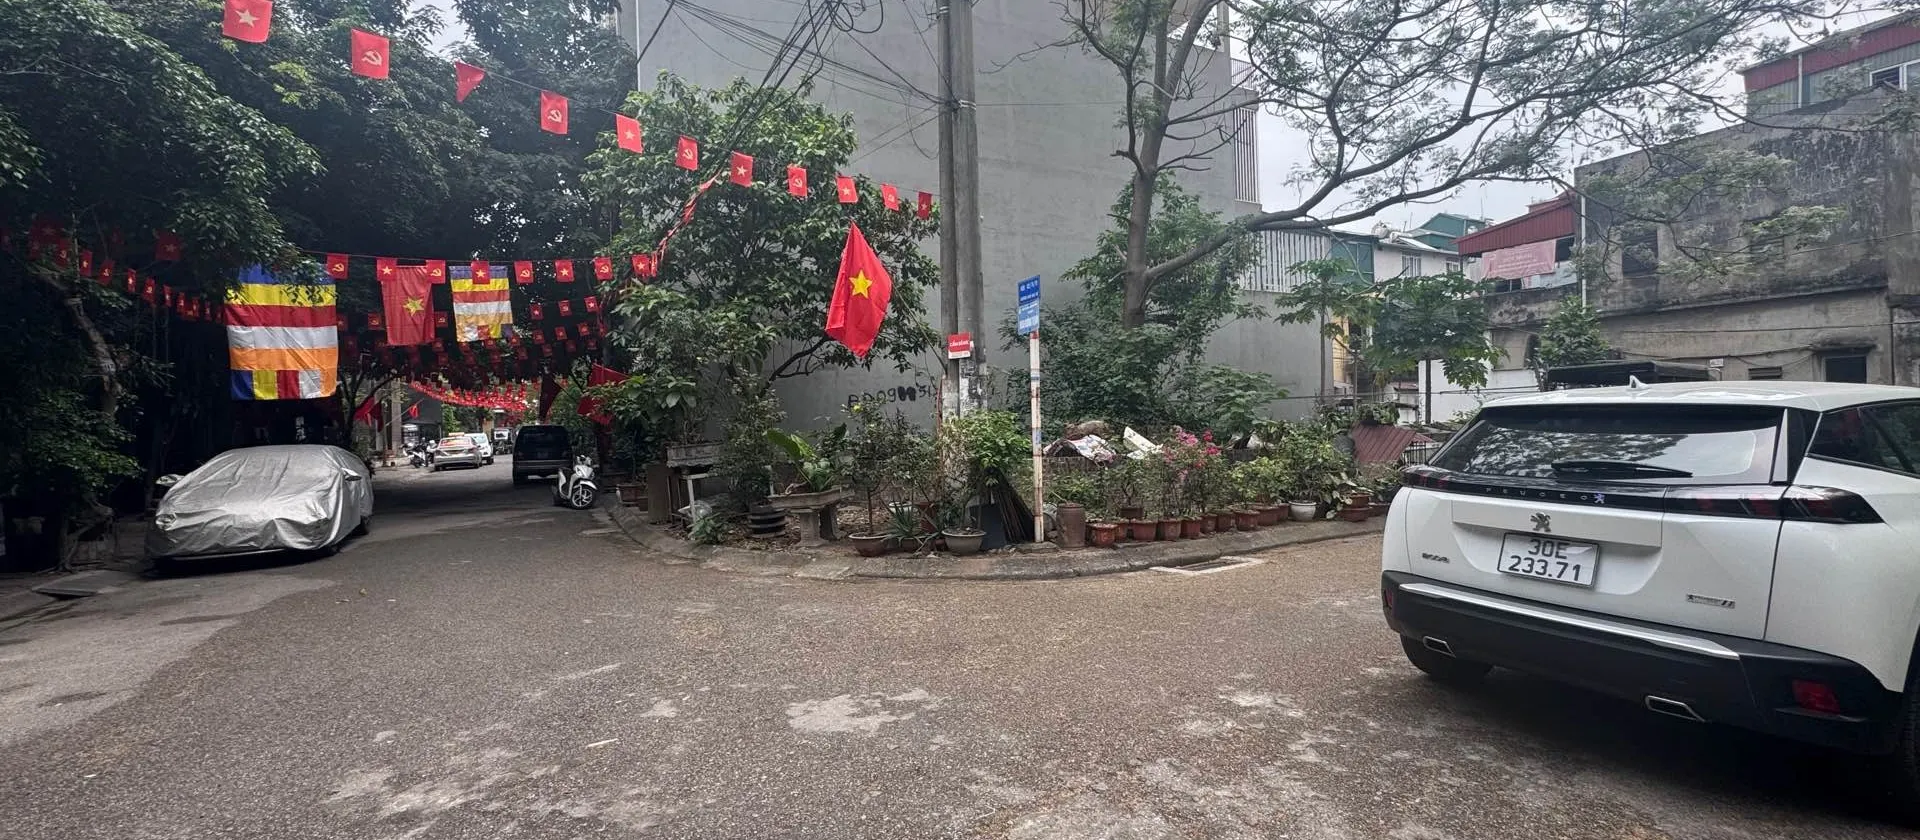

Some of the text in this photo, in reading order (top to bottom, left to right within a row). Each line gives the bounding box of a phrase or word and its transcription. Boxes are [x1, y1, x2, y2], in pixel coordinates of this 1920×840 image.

[1485, 487, 1604, 502] PEUGEO
[1528, 539, 1569, 559] 30E
[1508, 555, 1581, 581] 233.71
